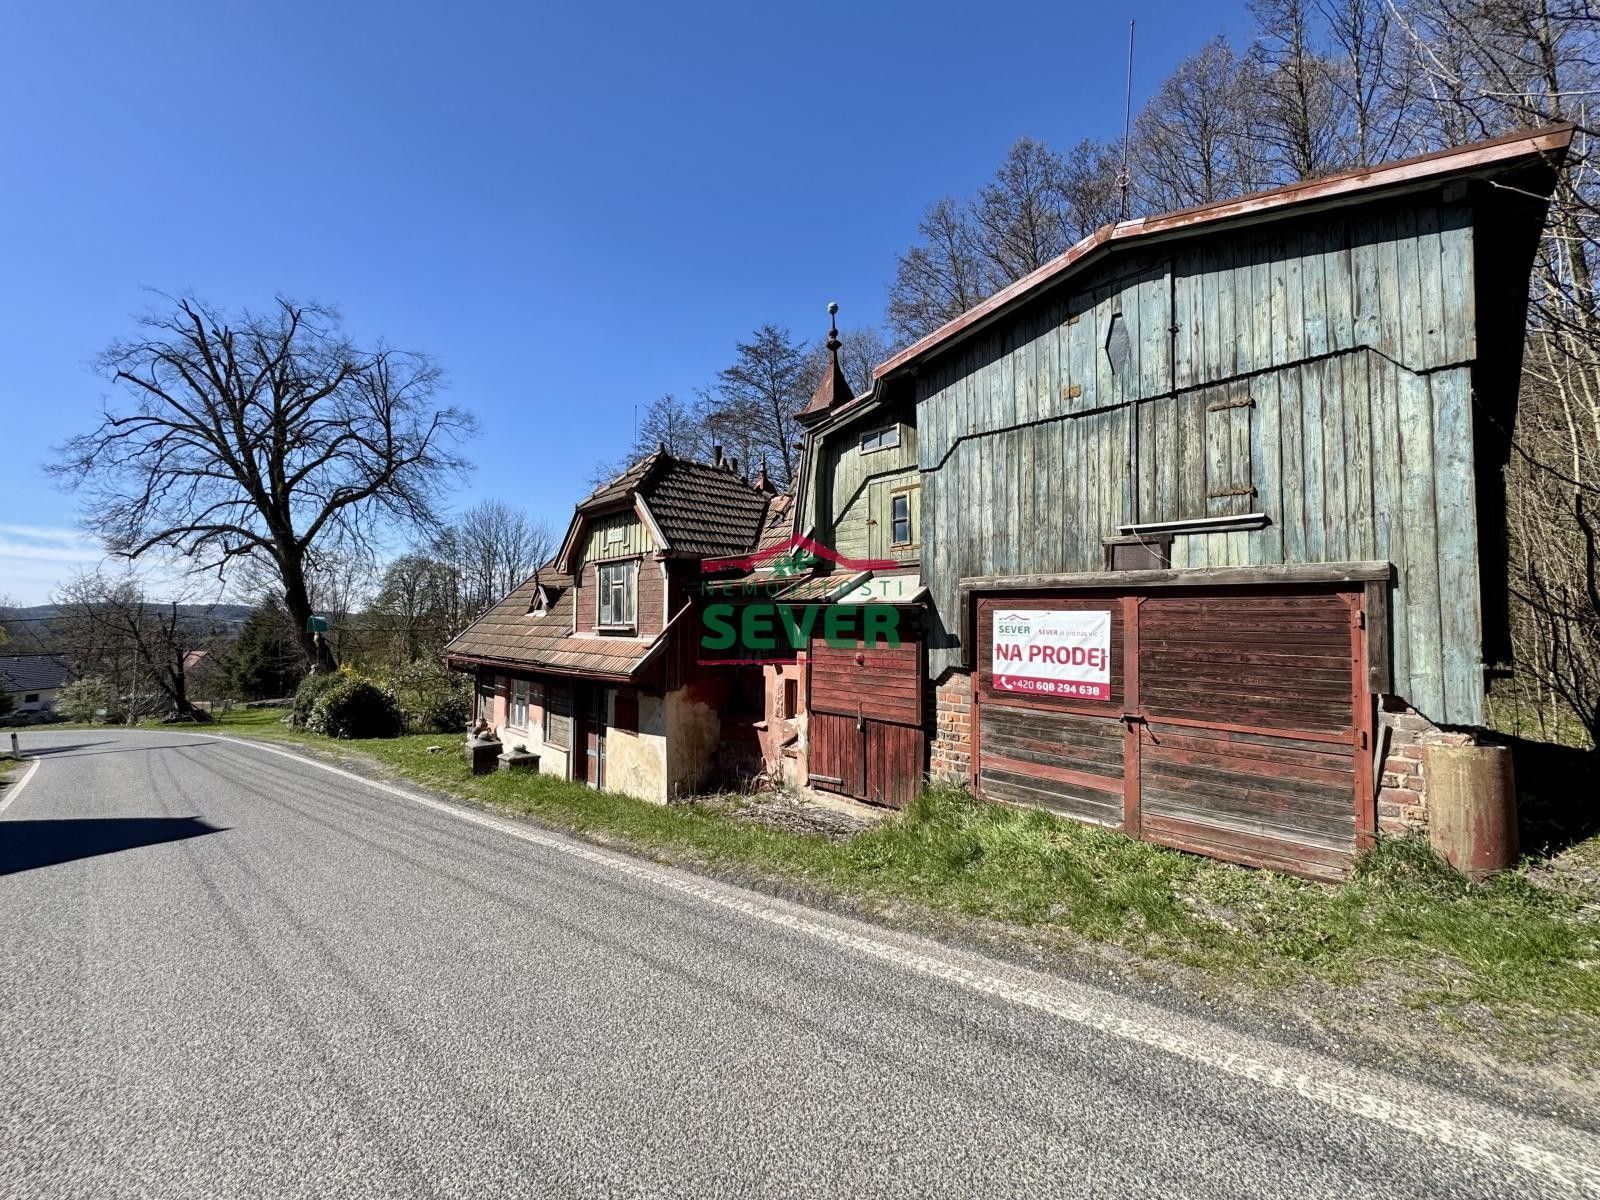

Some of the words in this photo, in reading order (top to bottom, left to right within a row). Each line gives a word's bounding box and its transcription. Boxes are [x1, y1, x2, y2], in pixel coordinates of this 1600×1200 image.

[998, 625, 1031, 635] SEVER
[996, 643, 1023, 662] NA
[1028, 644, 1106, 671] PRODEJ
[1012, 680, 1034, 689] +420
[1036, 682, 1055, 691] 608
[1057, 683, 1077, 693] 294
[1079, 685, 1100, 696] 638
